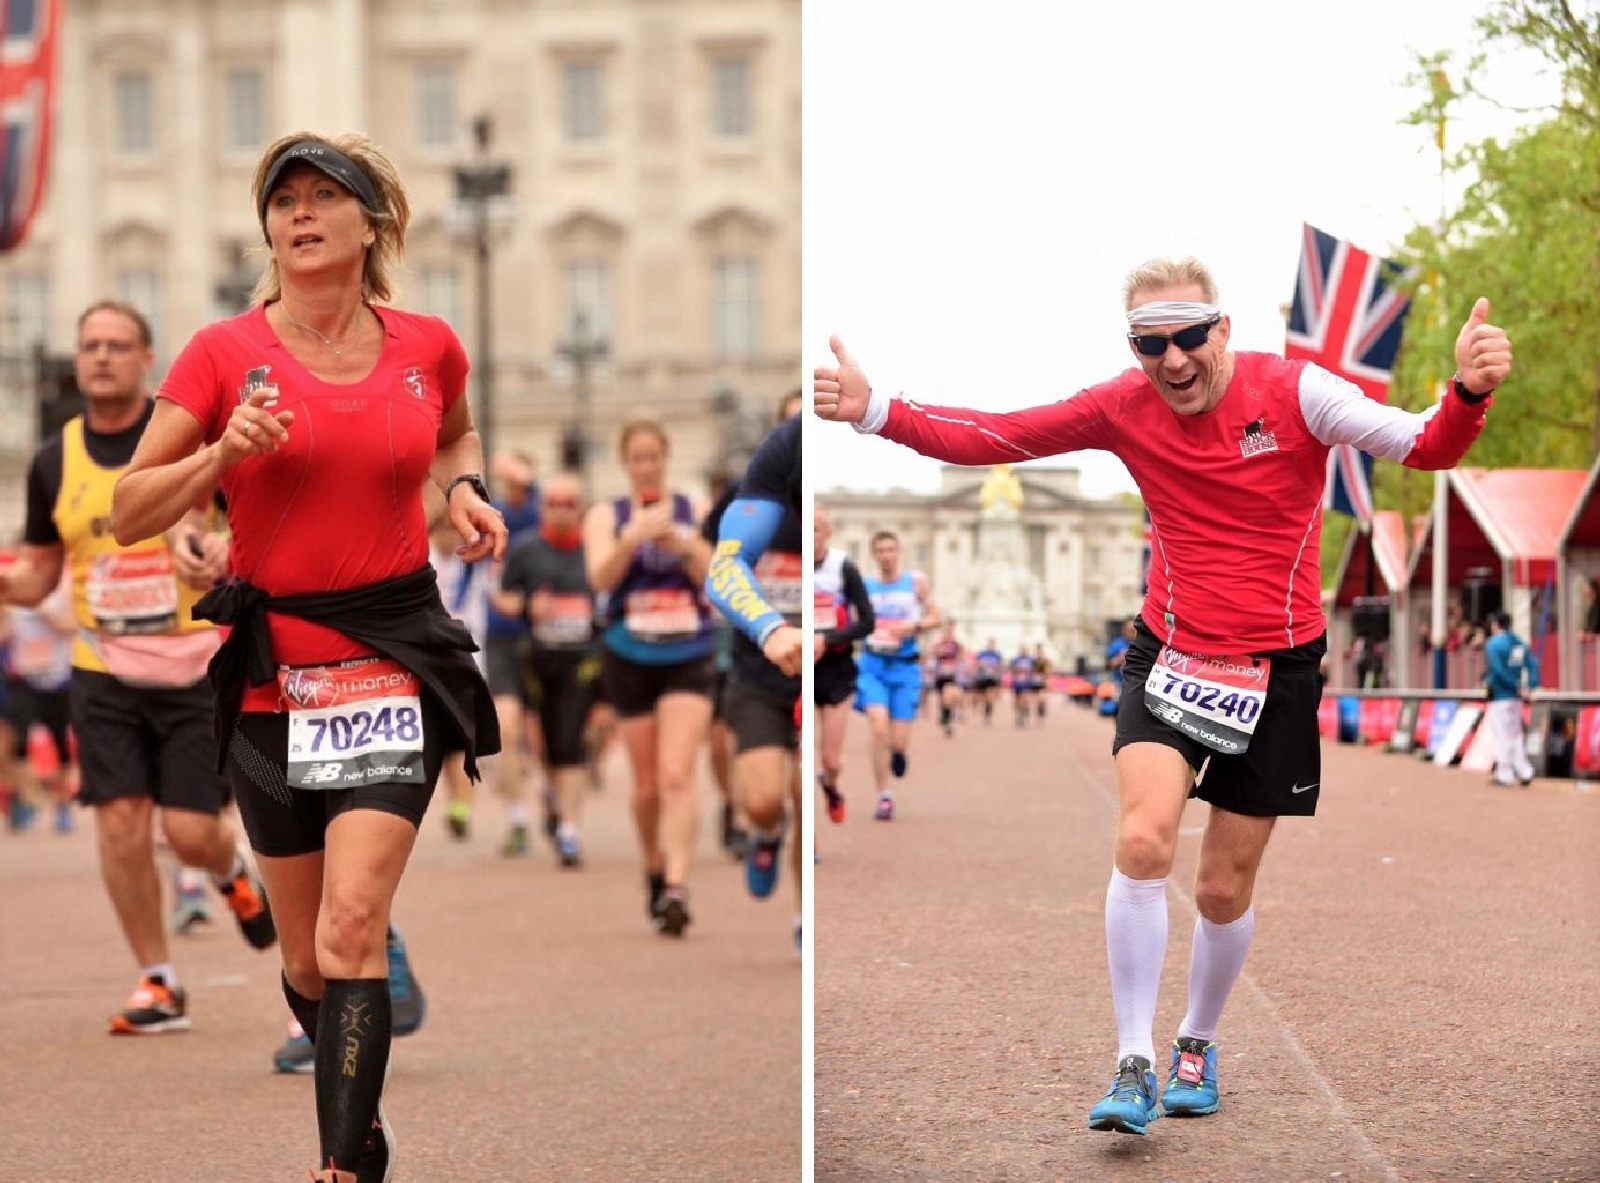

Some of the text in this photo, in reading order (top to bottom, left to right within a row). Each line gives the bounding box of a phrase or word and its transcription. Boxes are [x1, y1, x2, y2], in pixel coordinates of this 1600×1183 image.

[342, 671, 412, 694] money
[1208, 658, 1265, 682] money
[1163, 673, 1260, 724] 70240
[307, 706, 420, 754] 70248
[1181, 722, 1199, 735] new
[1200, 729, 1238, 750] balance
[344, 771, 364, 783] new
[367, 765, 413, 778] balance
